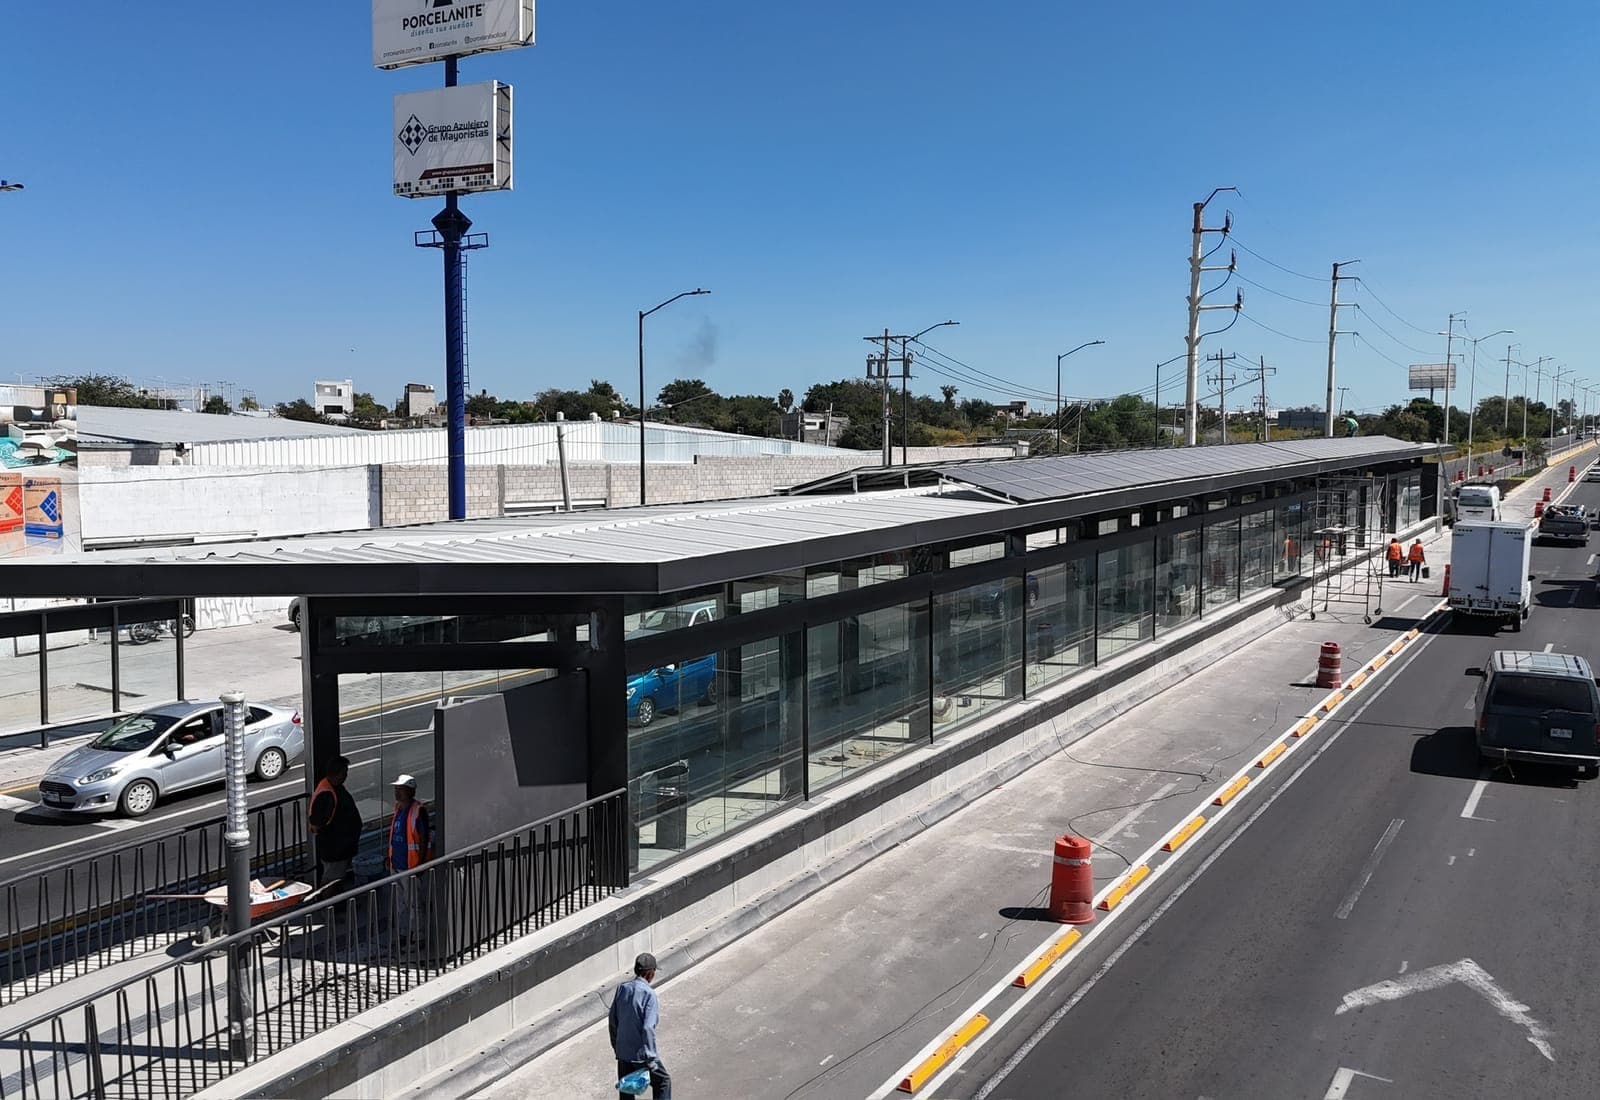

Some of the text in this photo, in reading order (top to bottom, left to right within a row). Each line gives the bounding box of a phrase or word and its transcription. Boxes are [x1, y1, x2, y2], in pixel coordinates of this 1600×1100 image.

[402, 3, 483, 30] PORCELANITE
[436, 25, 447, 33] tus
[428, 120, 489, 133] Grupo Azulejero
[428, 129, 489, 142] de Mayoristas
